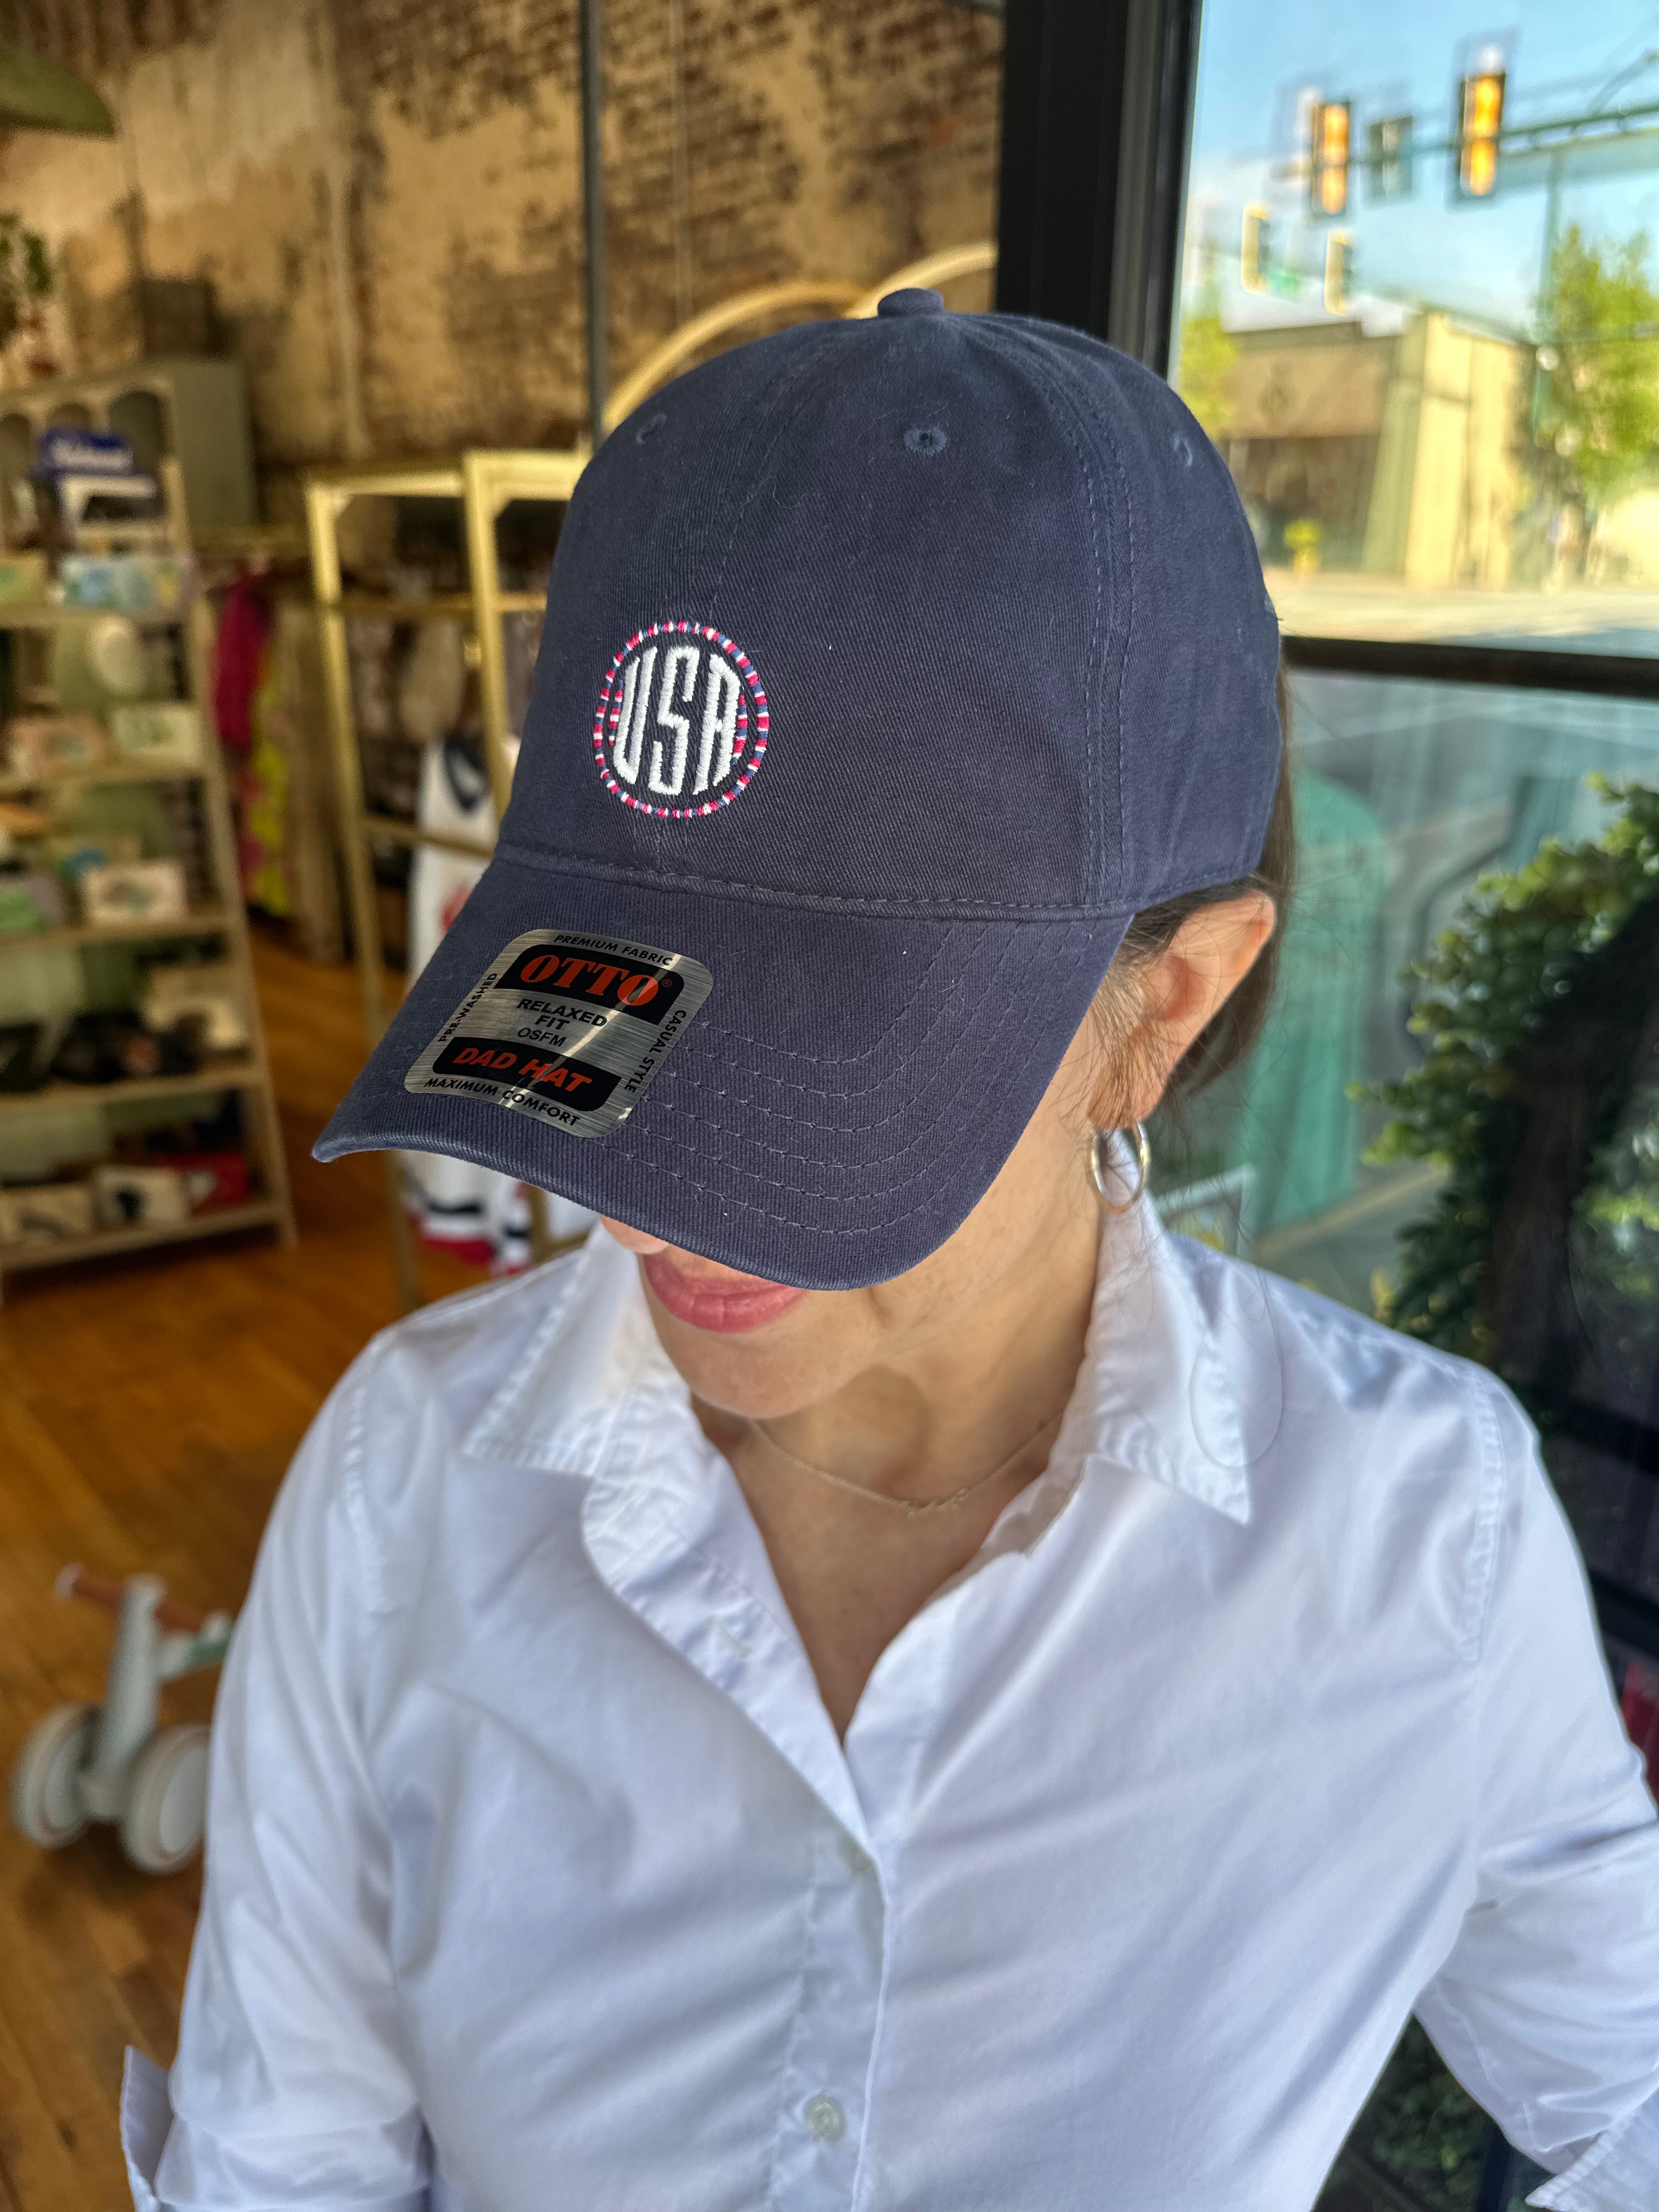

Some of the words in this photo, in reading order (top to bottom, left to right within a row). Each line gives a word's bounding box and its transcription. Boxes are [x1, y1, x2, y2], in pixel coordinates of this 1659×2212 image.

[613, 646, 740, 795] USA
[554, 935, 618, 952] PREMIUM
[622, 946, 673, 966] FABRIC
[439, 973, 497, 1042] PRE-WASHED
[517, 998, 607, 1027] RELAXED
[535, 1015, 570, 1030] FIT
[517, 1028, 566, 1047] OSFM
[649, 1010, 686, 1053] CASUAL
[453, 1048, 517, 1069] DAD
[519, 1060, 592, 1091] HAT
[624, 1057, 655, 1092] STYLE
[425, 1078, 498, 1095] MAXIMUM
[503, 1091, 580, 1126] COMFORT
